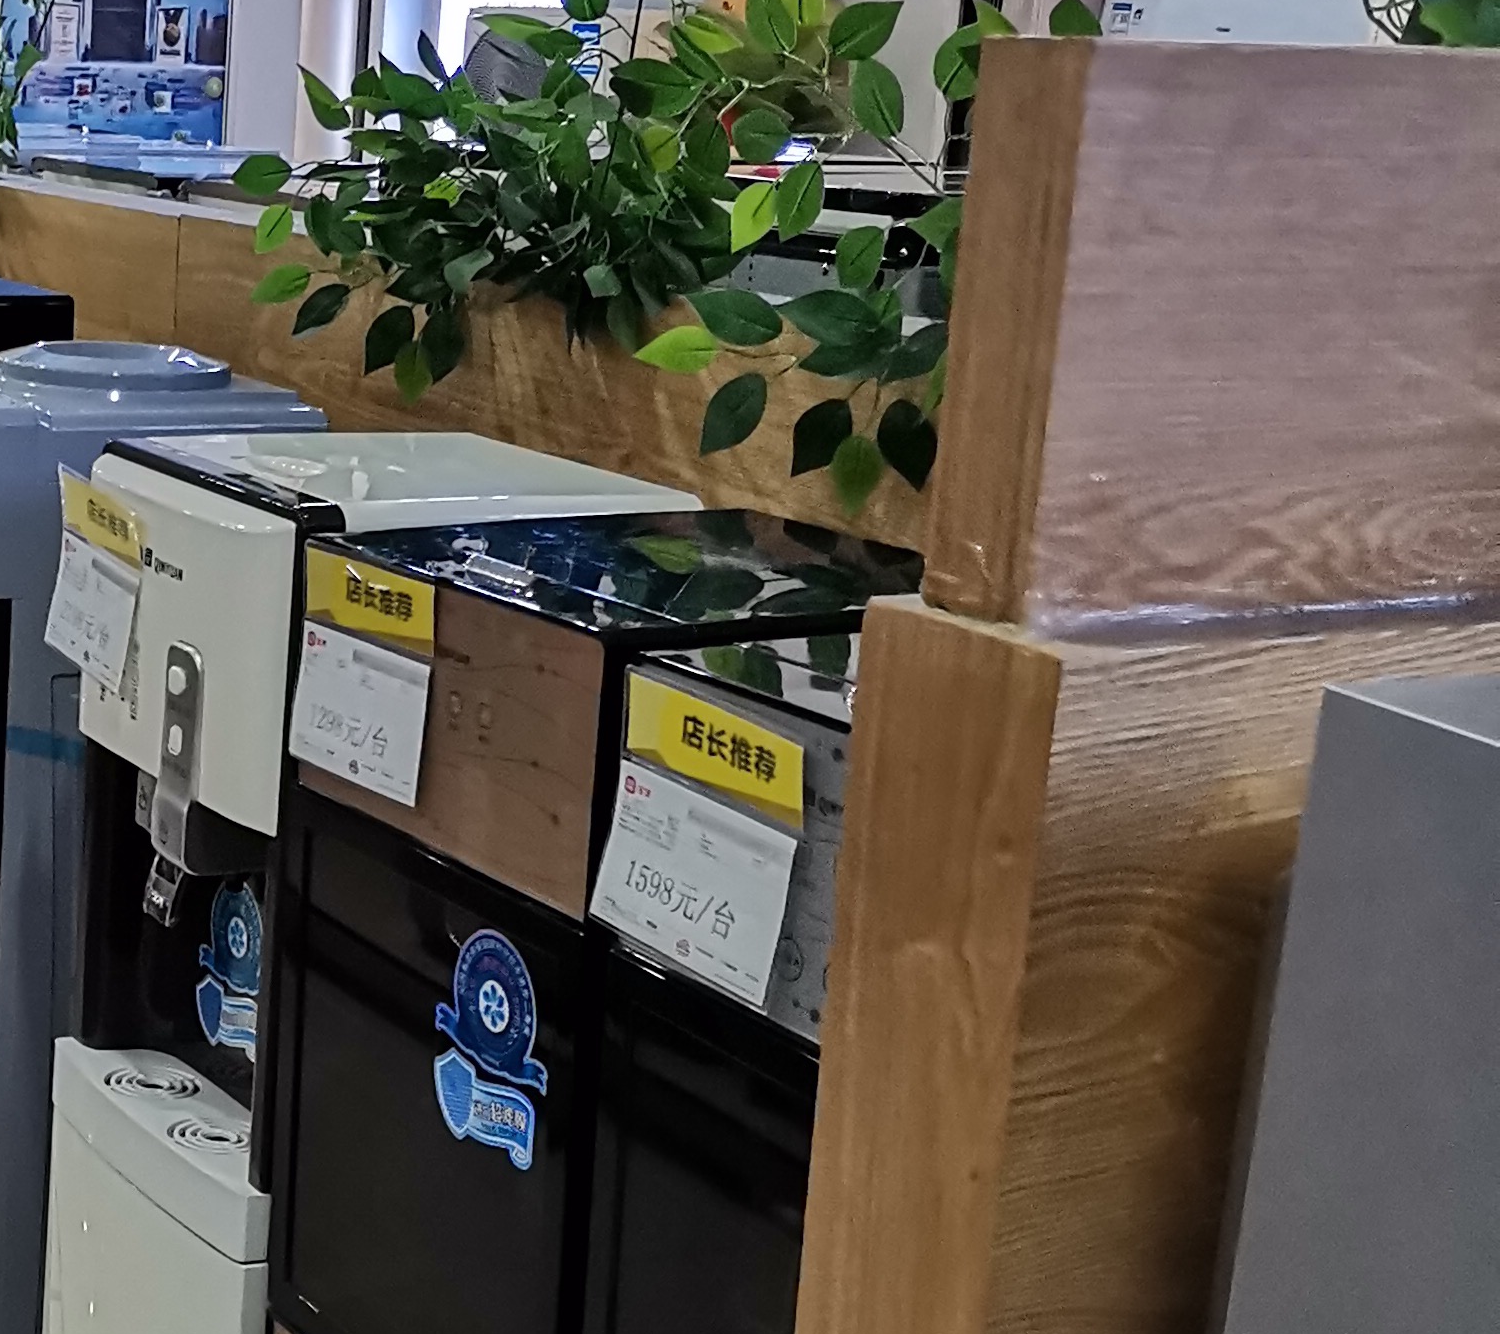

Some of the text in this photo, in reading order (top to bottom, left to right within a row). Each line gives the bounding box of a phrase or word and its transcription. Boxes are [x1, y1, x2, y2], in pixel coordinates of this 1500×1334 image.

[681, 714, 777, 783] 店长推荐
[625, 859, 736, 941] 1598元/台
